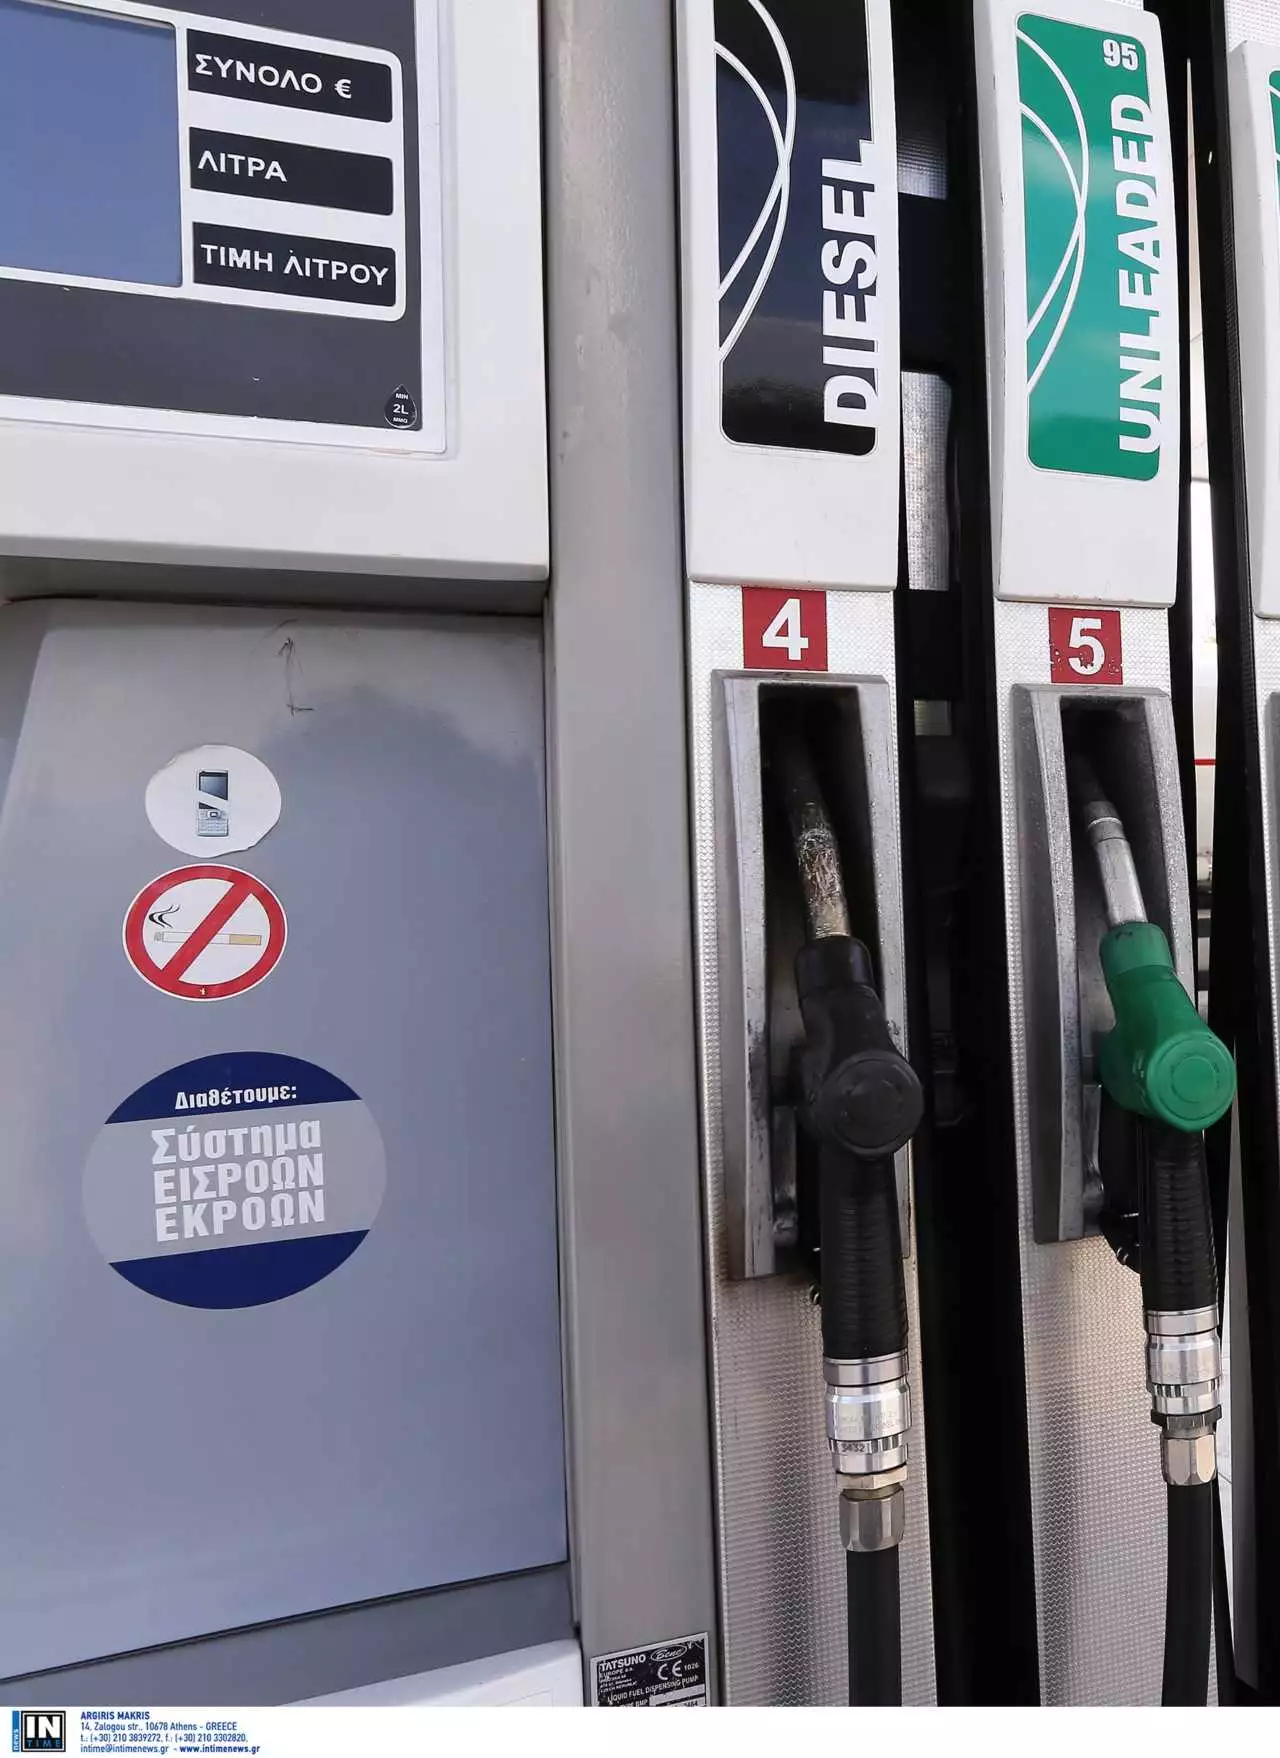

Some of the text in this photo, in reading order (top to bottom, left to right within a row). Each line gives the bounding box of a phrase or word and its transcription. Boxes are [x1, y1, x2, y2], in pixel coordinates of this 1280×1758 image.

[195, 53, 352, 99] ΣΥΝΟΛΟ €
[1102, 38, 1139, 70] 95
[198, 150, 287, 182] ΛΙΤΡΑ
[200, 244, 389, 286] ΤΙΜΗ ΛΙΤΡΟΥ
[820, 138, 878, 429] DIESEL
[1109, 94, 1163, 455] UNLEADED
[393, 404, 409, 415] 2L
[762, 599, 808, 661] 4
[1068, 617, 1105, 676] 5
[175, 1085, 297, 1110] Διαθέτουμε:
[151, 1120, 321, 1165] Σύστημα
[153, 1153, 324, 1205] ΕΙΣΡΟΩΝ
[156, 1189, 325, 1242] ΕΚΡΟΩΝ
[600, 1654, 646, 1671] TATSUNO
[629, 1688, 644, 1697] FUEL
